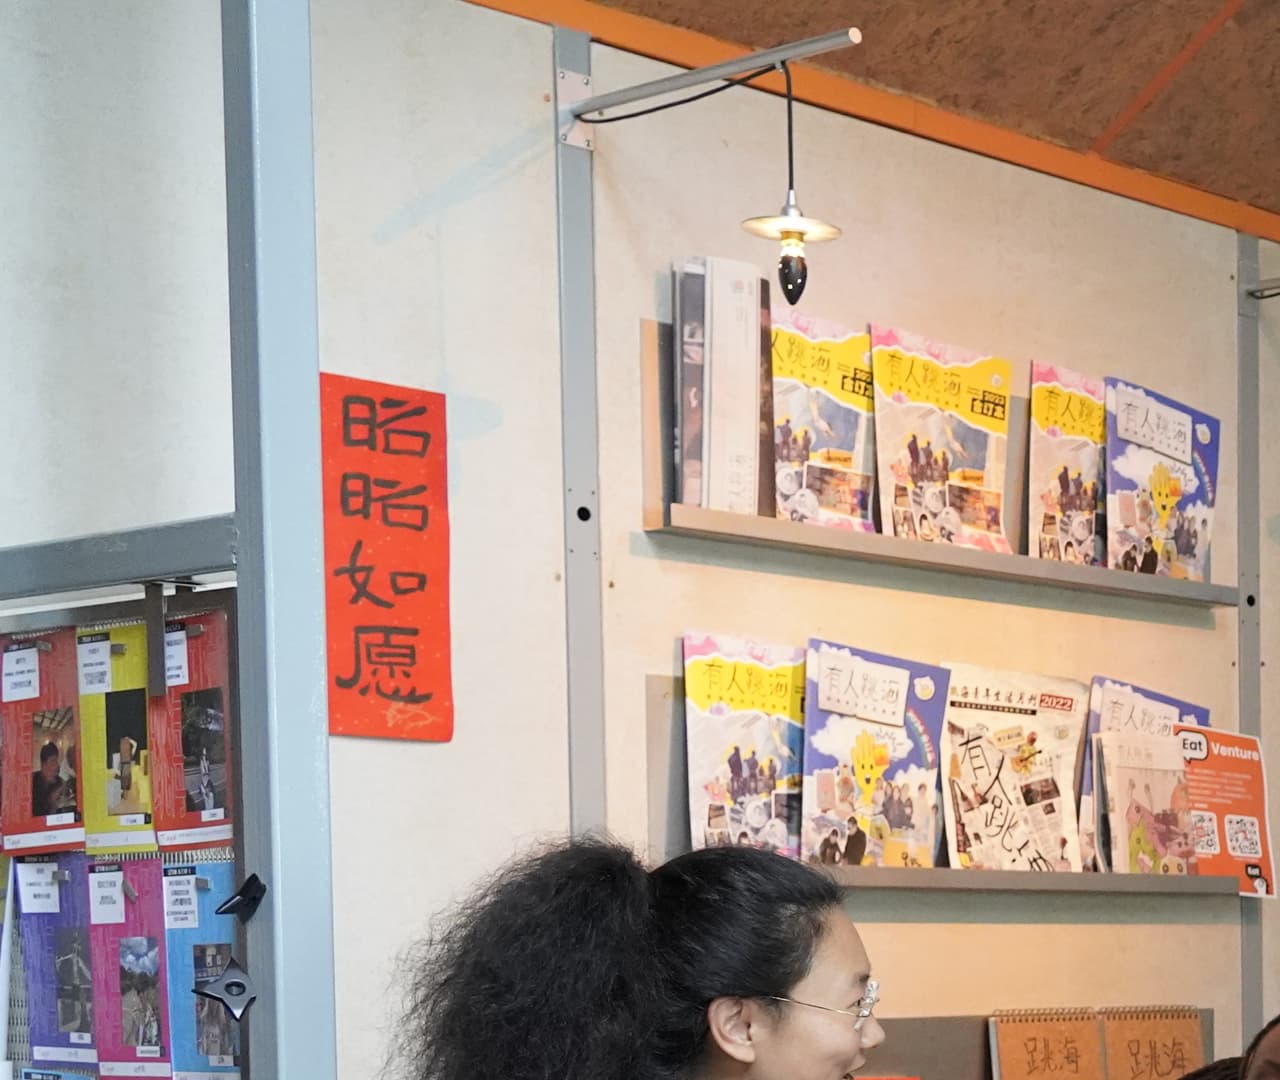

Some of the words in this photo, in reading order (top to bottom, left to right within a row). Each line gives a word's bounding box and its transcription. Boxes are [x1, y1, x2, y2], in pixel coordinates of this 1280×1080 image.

[334, 394, 433, 704] 昭昭如愿
[1040, 694, 1073, 711] 2022
[1182, 737, 1204, 752] Eat
[1211, 741, 1260, 761] Venture
[1024, 1036, 1082, 1075] 跳海
